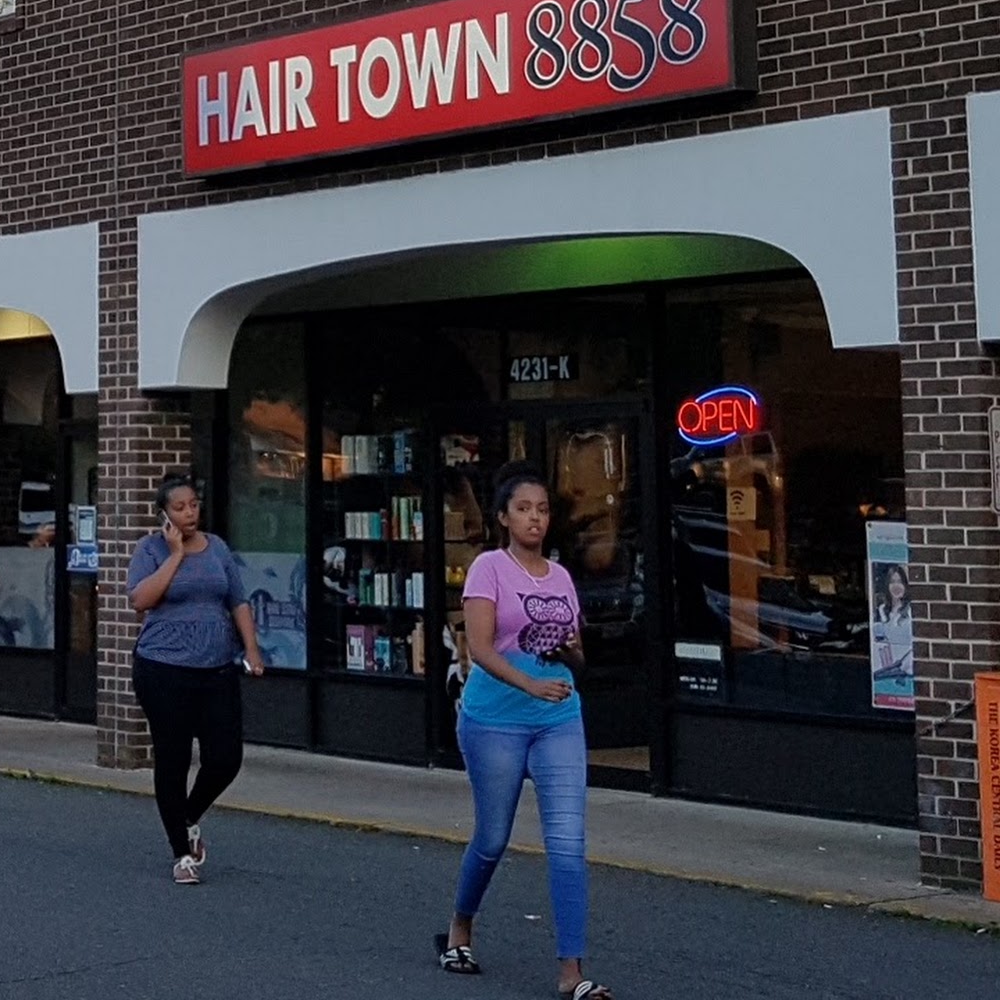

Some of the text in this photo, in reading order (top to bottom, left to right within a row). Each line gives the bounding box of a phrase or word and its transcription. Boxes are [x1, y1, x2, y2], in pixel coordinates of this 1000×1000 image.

[197, 55, 317, 147] HAIR
[329, 11, 511, 125] TOWN
[510, 355, 570, 382] 4231-K
[678, 397, 756, 433] OPEN
[988, 701, 999, 725] THE
[989, 728, 1000, 771] KOREA
